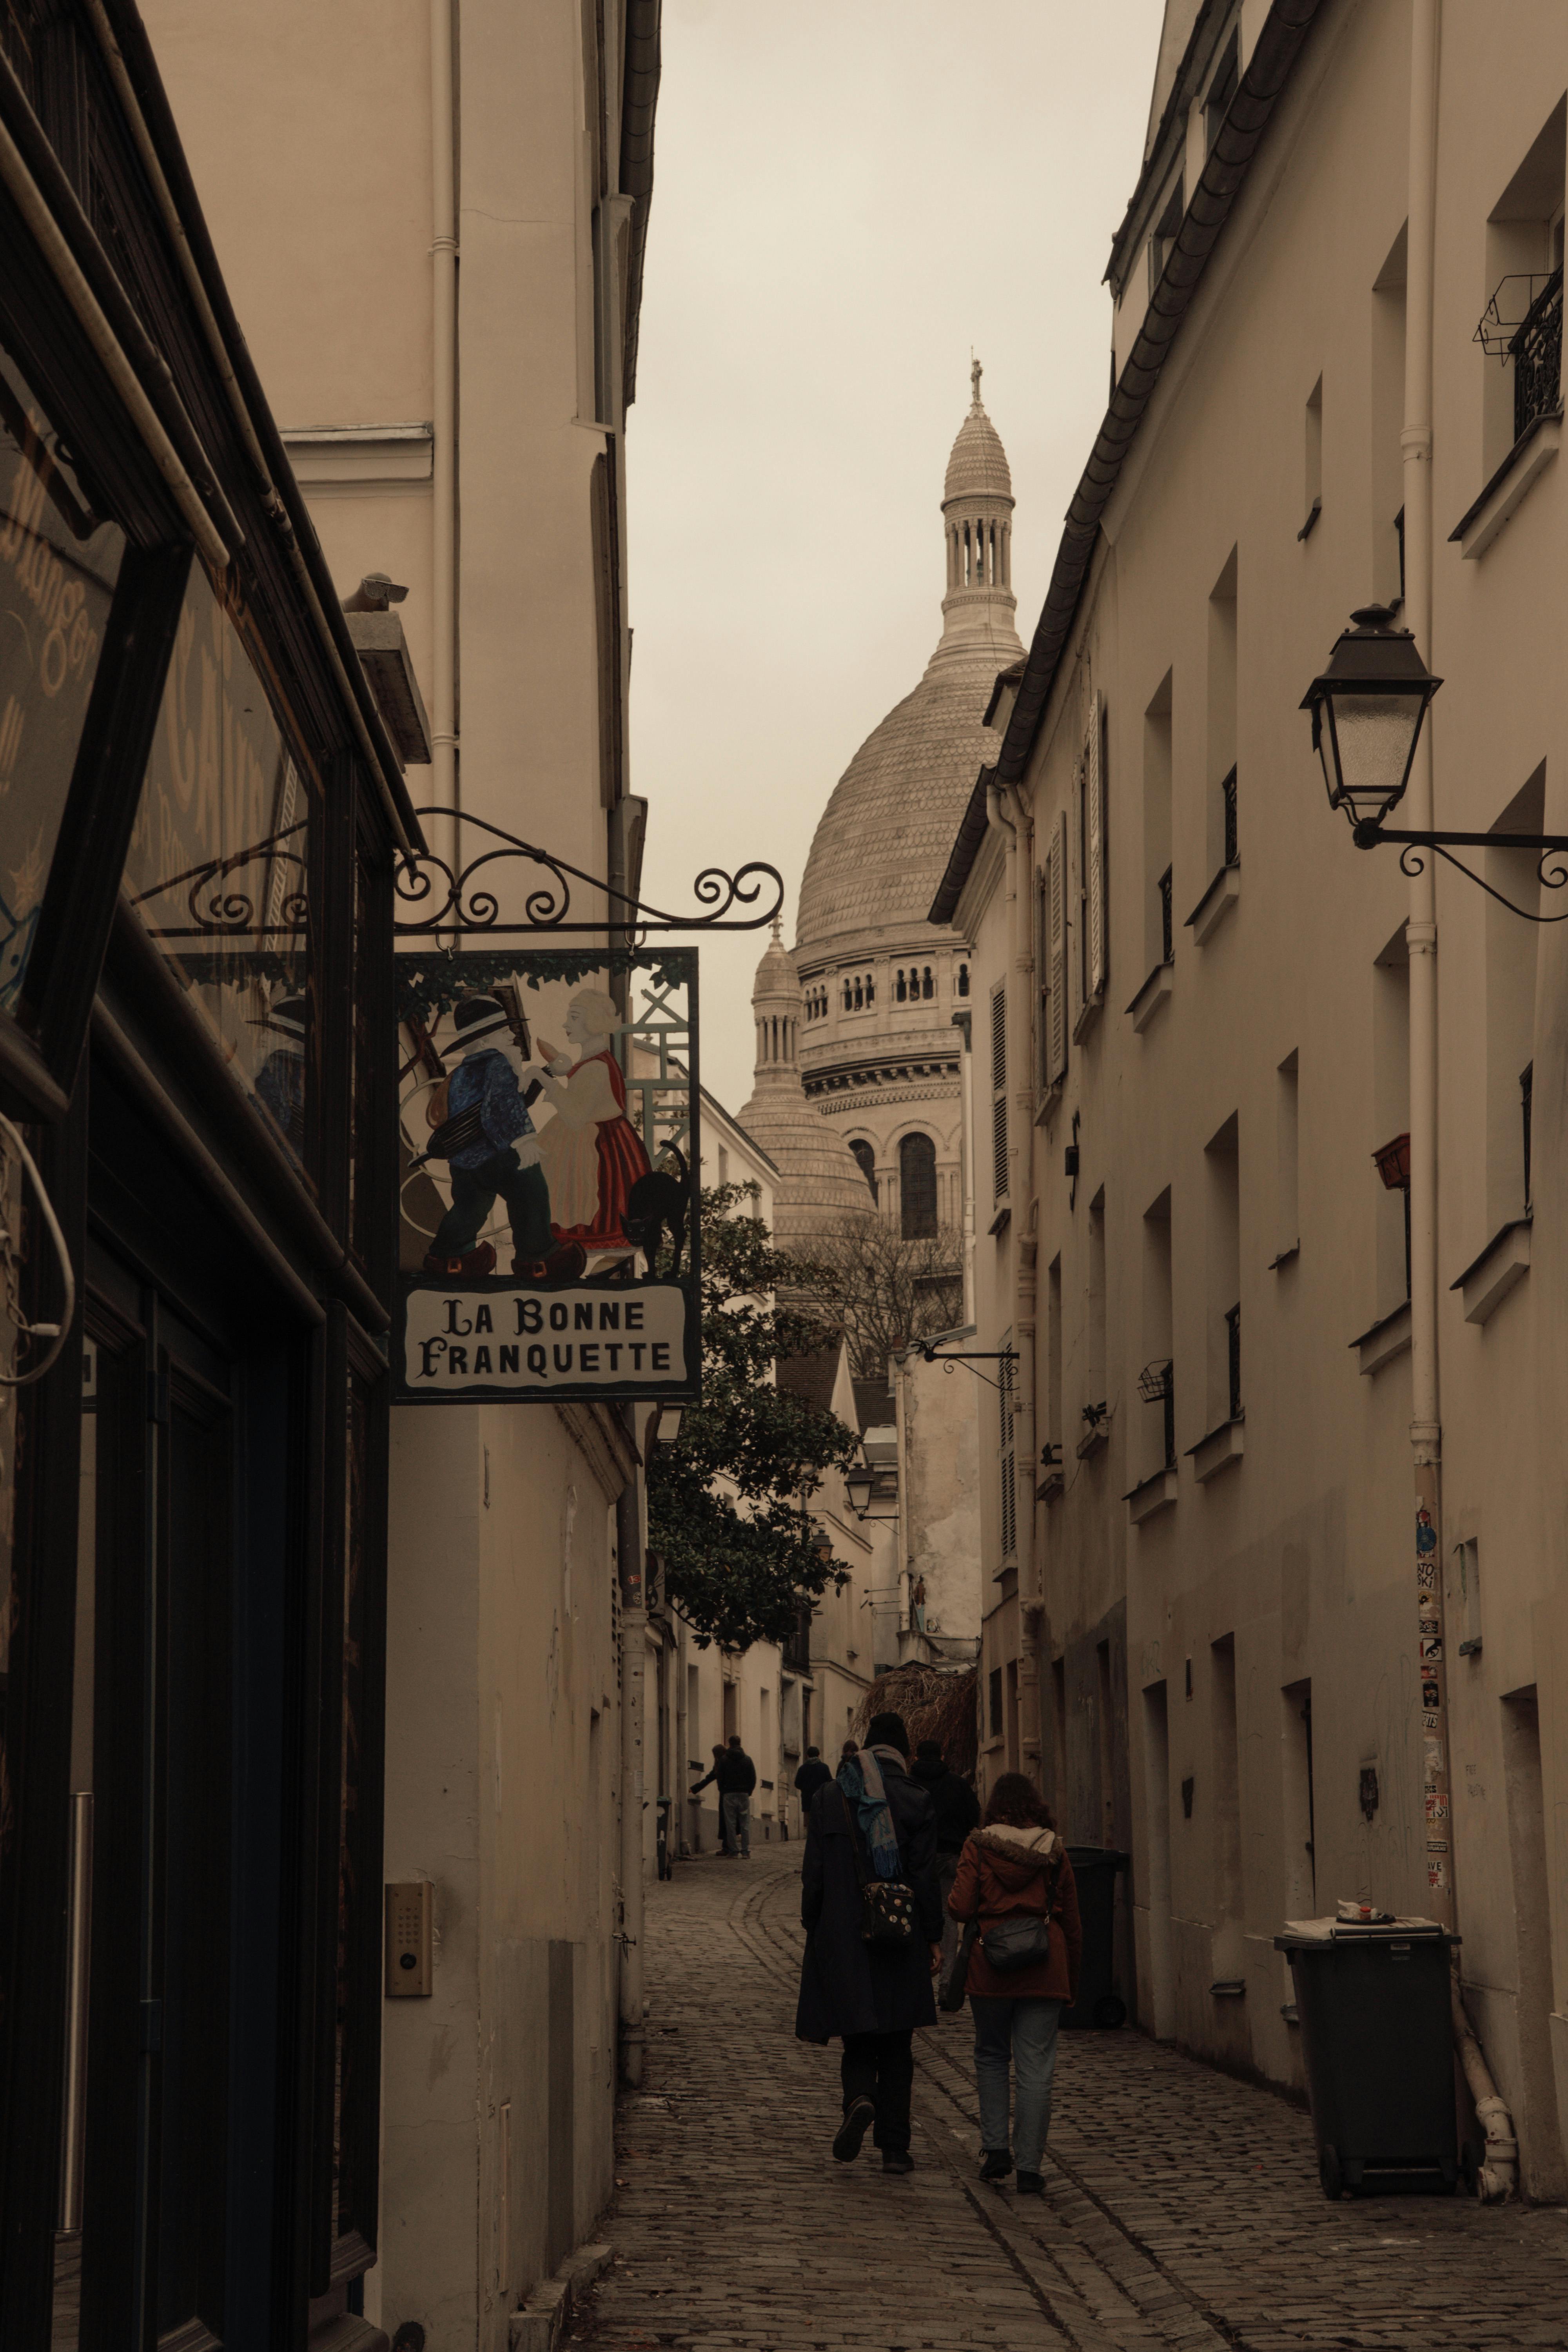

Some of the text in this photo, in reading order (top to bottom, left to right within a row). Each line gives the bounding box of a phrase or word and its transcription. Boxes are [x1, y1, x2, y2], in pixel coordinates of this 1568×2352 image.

[442, 1298, 644, 1337] LA BONNE
[415, 1336, 670, 1379] FRANQUETTE
